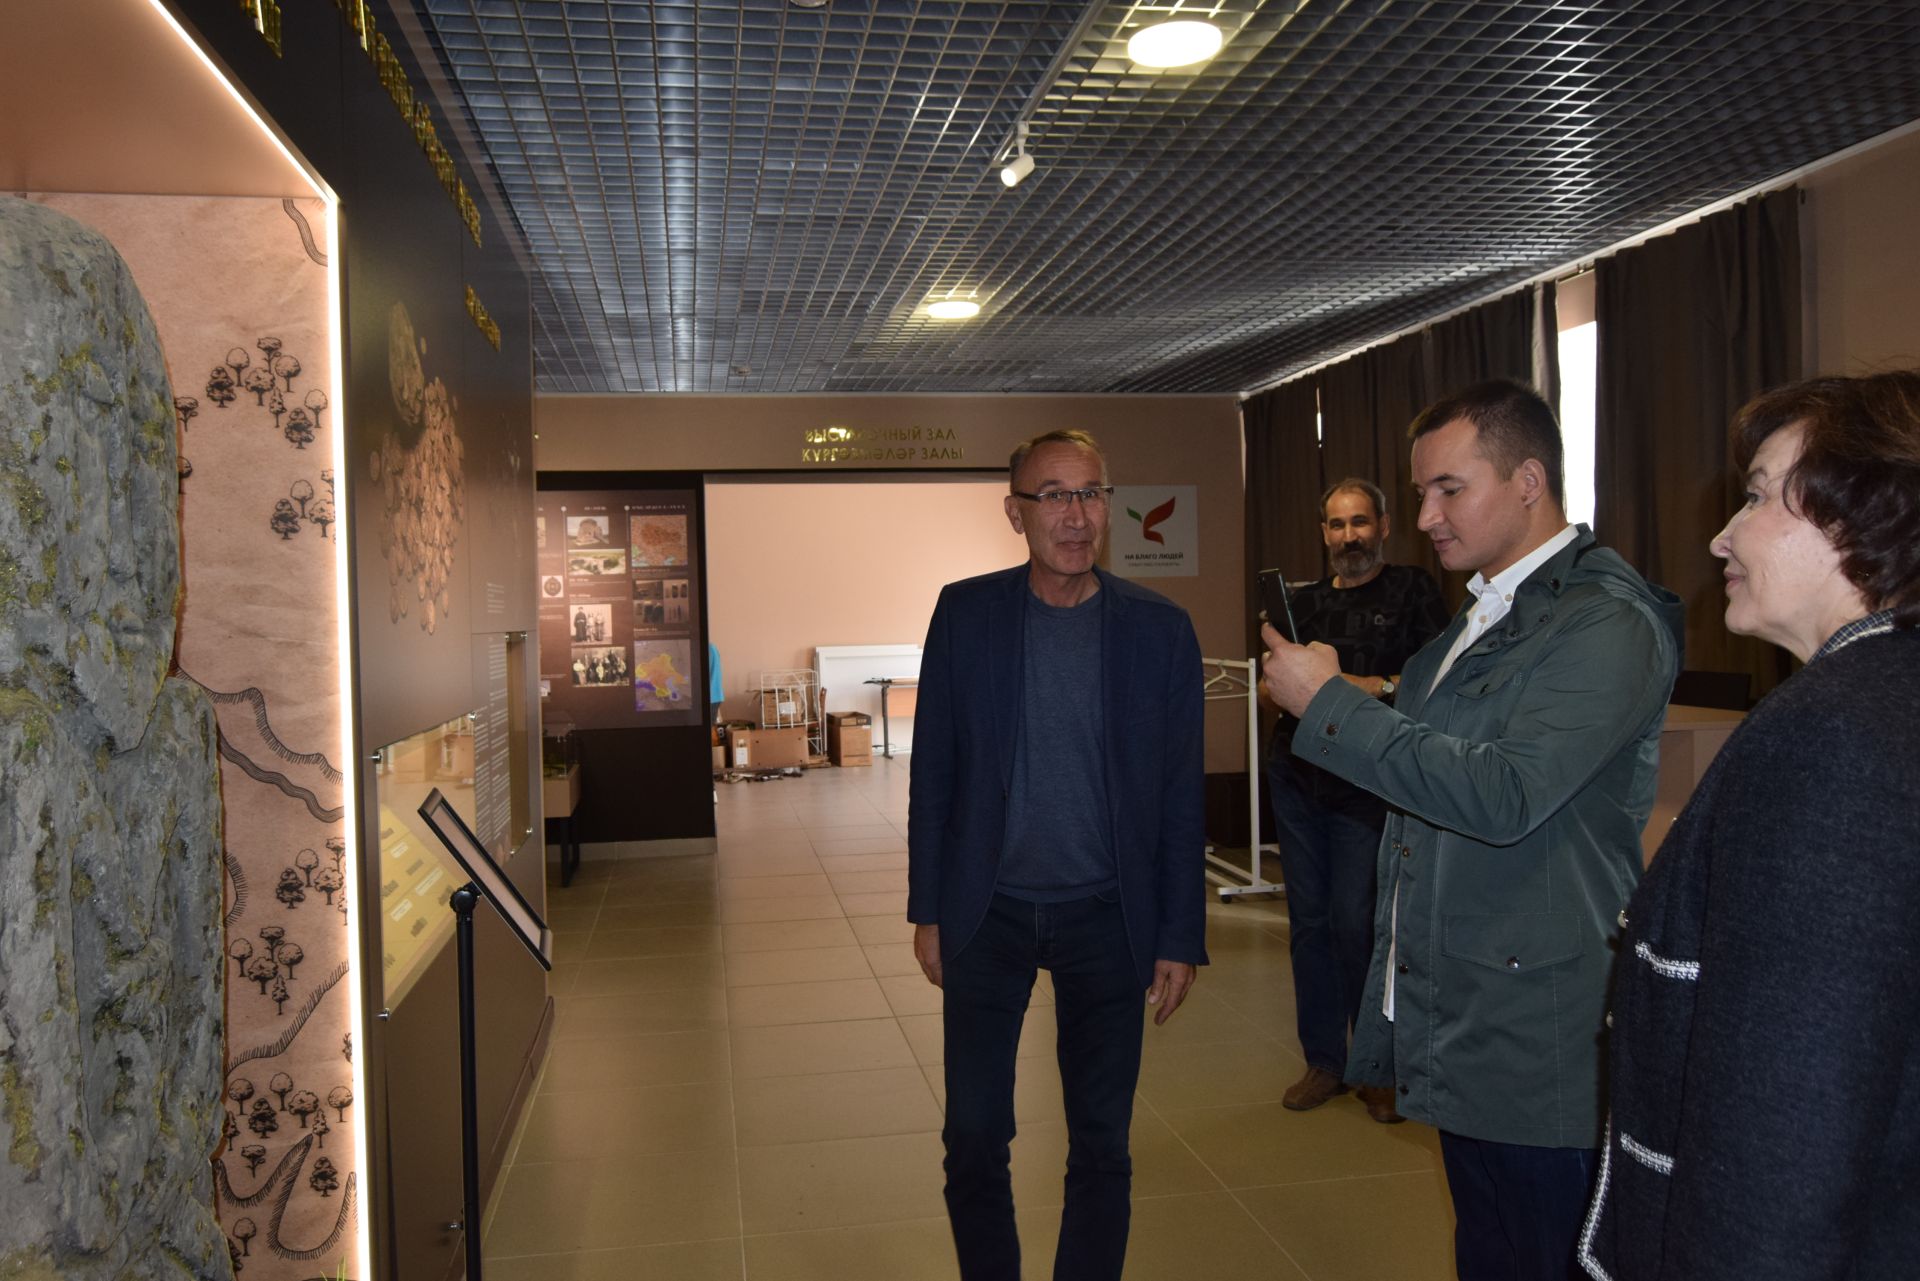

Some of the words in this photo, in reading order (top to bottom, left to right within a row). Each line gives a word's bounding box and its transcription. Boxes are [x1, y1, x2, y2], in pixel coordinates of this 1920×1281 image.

[805, 425, 921, 443] ВЫСТАОЧНЫЙ
[927, 428, 957, 442] ЗАЛ
[921, 447, 964, 461] ЗАЛЫ
[1158, 552, 1184, 560] ЛЮДЕЙ
